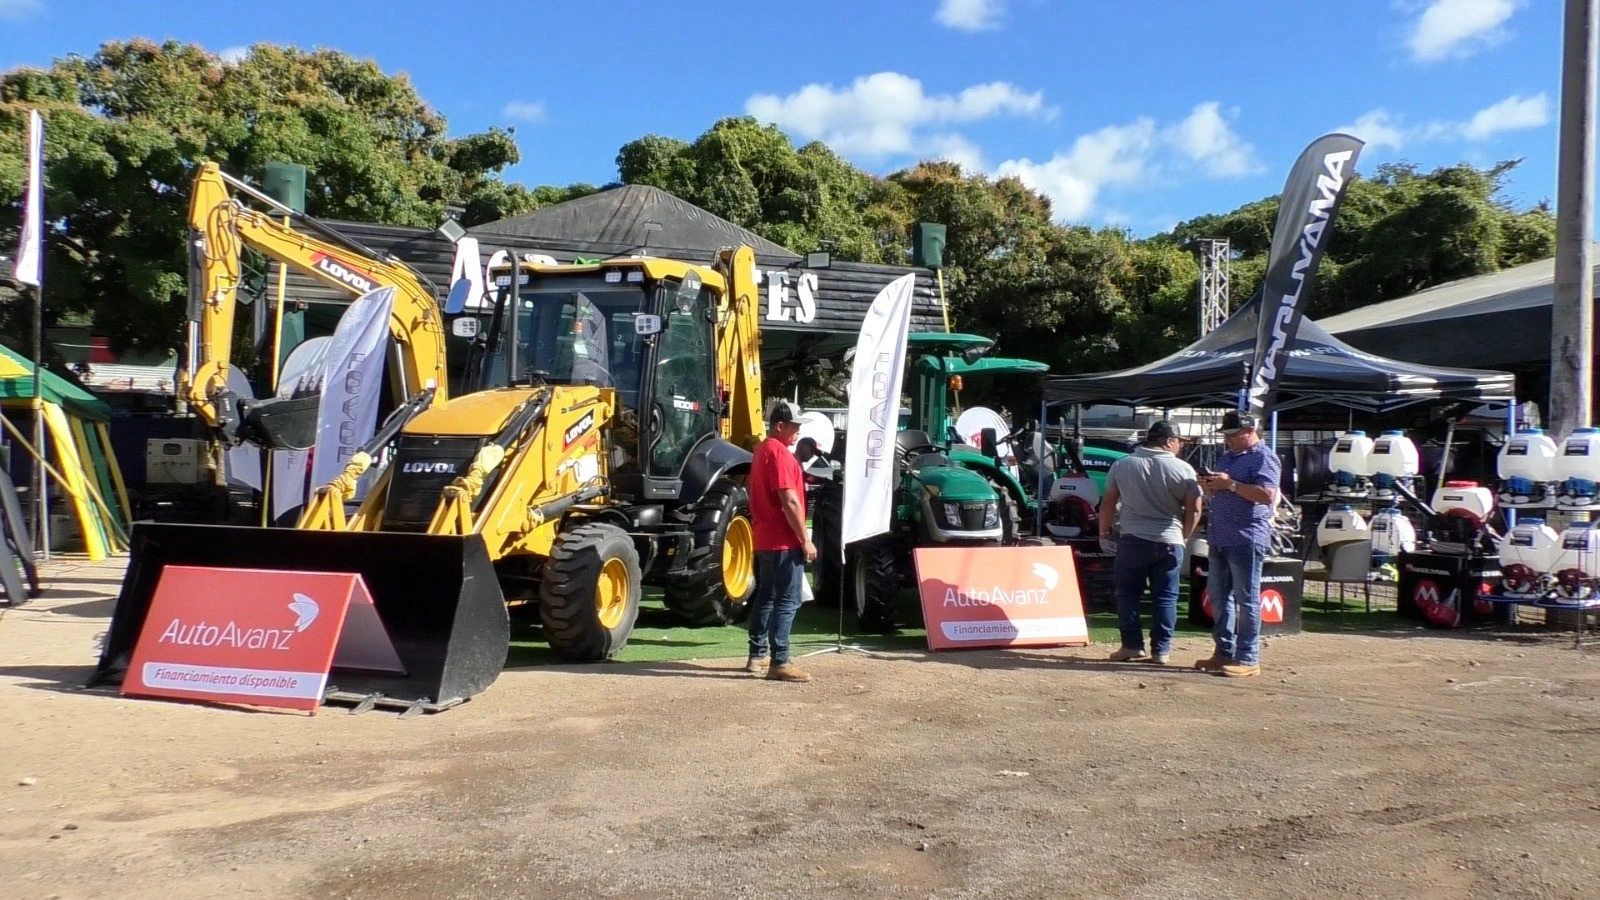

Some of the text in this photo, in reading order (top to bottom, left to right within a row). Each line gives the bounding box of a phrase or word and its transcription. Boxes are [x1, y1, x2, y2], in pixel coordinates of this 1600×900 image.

[320, 258, 372, 293] LOVOL
[337, 352, 365, 463] LOVOL
[865, 352, 890, 478] LOVOL
[565, 415, 593, 444] LOVOL
[403, 462, 456, 473] LOVOL
[943, 585, 1050, 607] AutoAvanz
[158, 618, 295, 650] AutoAvanz
[154, 667, 298, 690] Financiamiento disponible
